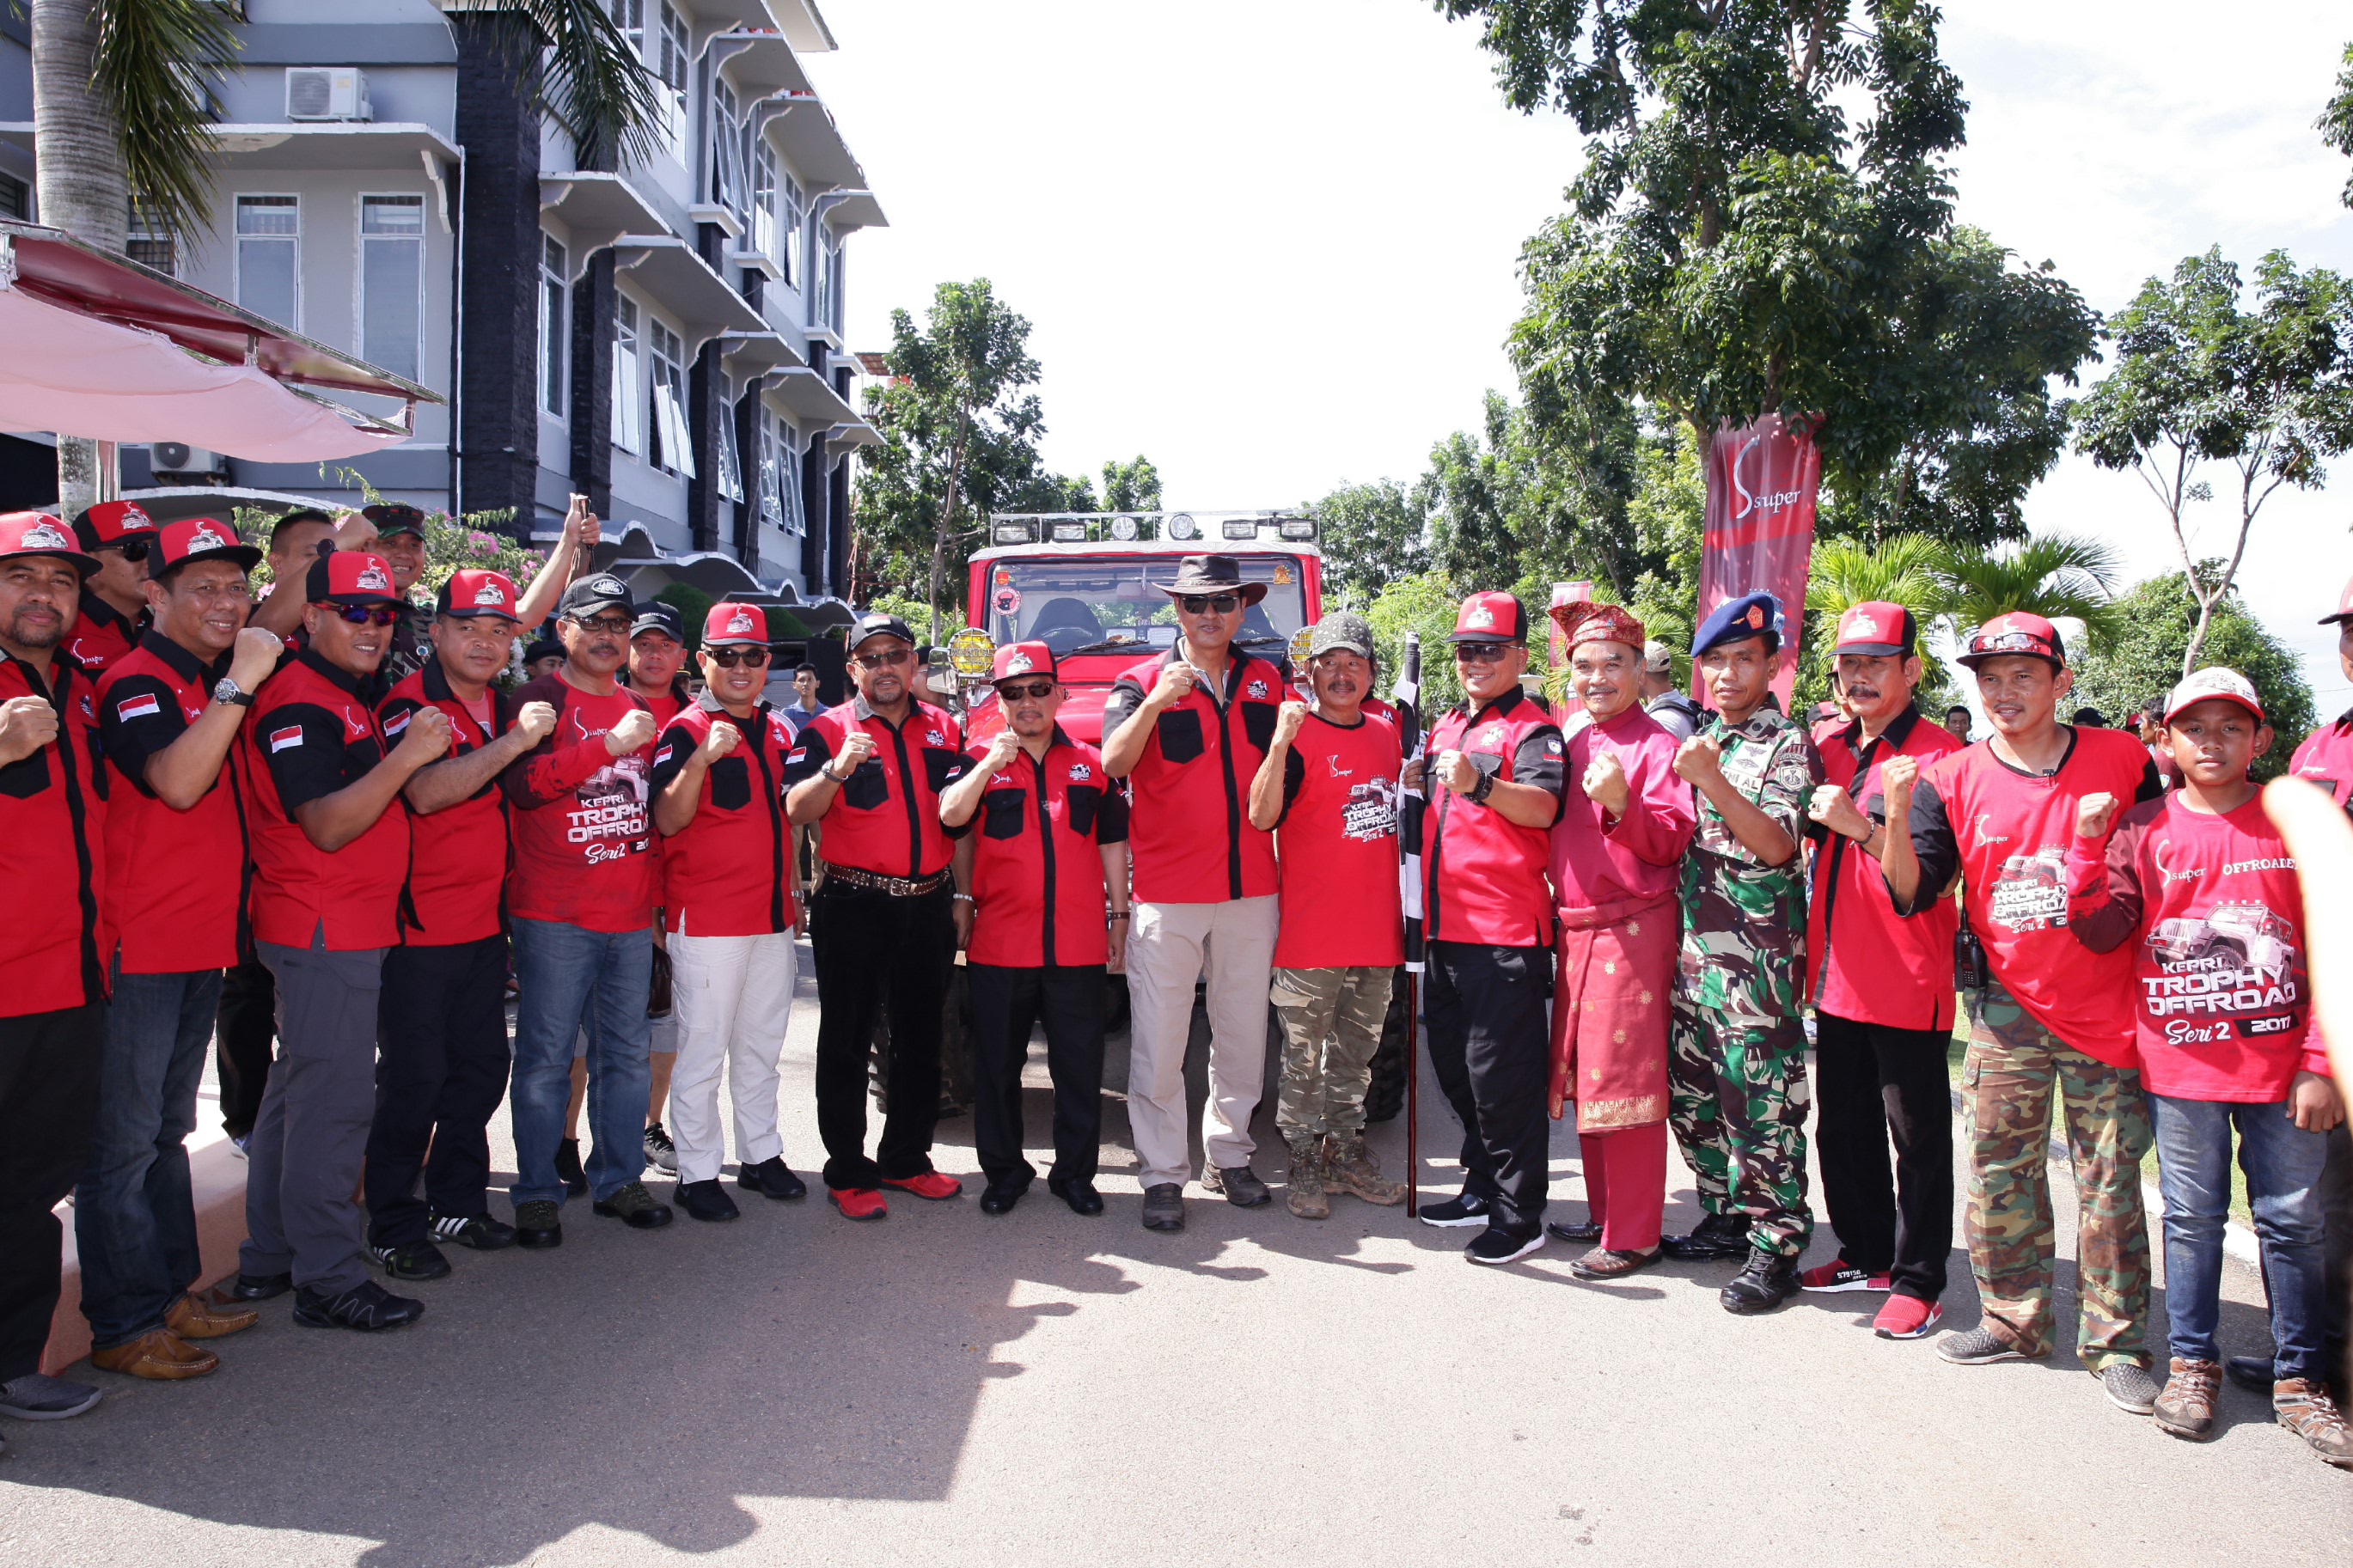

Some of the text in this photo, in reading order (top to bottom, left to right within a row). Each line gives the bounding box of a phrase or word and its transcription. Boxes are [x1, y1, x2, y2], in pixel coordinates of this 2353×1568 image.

[1754, 491, 1801, 514] super
[1742, 778, 1758, 790] AL
[580, 794, 625, 808] KEPRI
[1343, 803, 1391, 822] TROPHY
[2171, 868, 2207, 882] super
[2037, 918, 2045, 929] 2
[2161, 957, 2223, 974] KEPRI
[2142, 964, 2283, 997] TROPHY
[2146, 981, 2296, 1016] OFFROAD
[2165, 1016, 2291, 1045] Seri 2 2017
